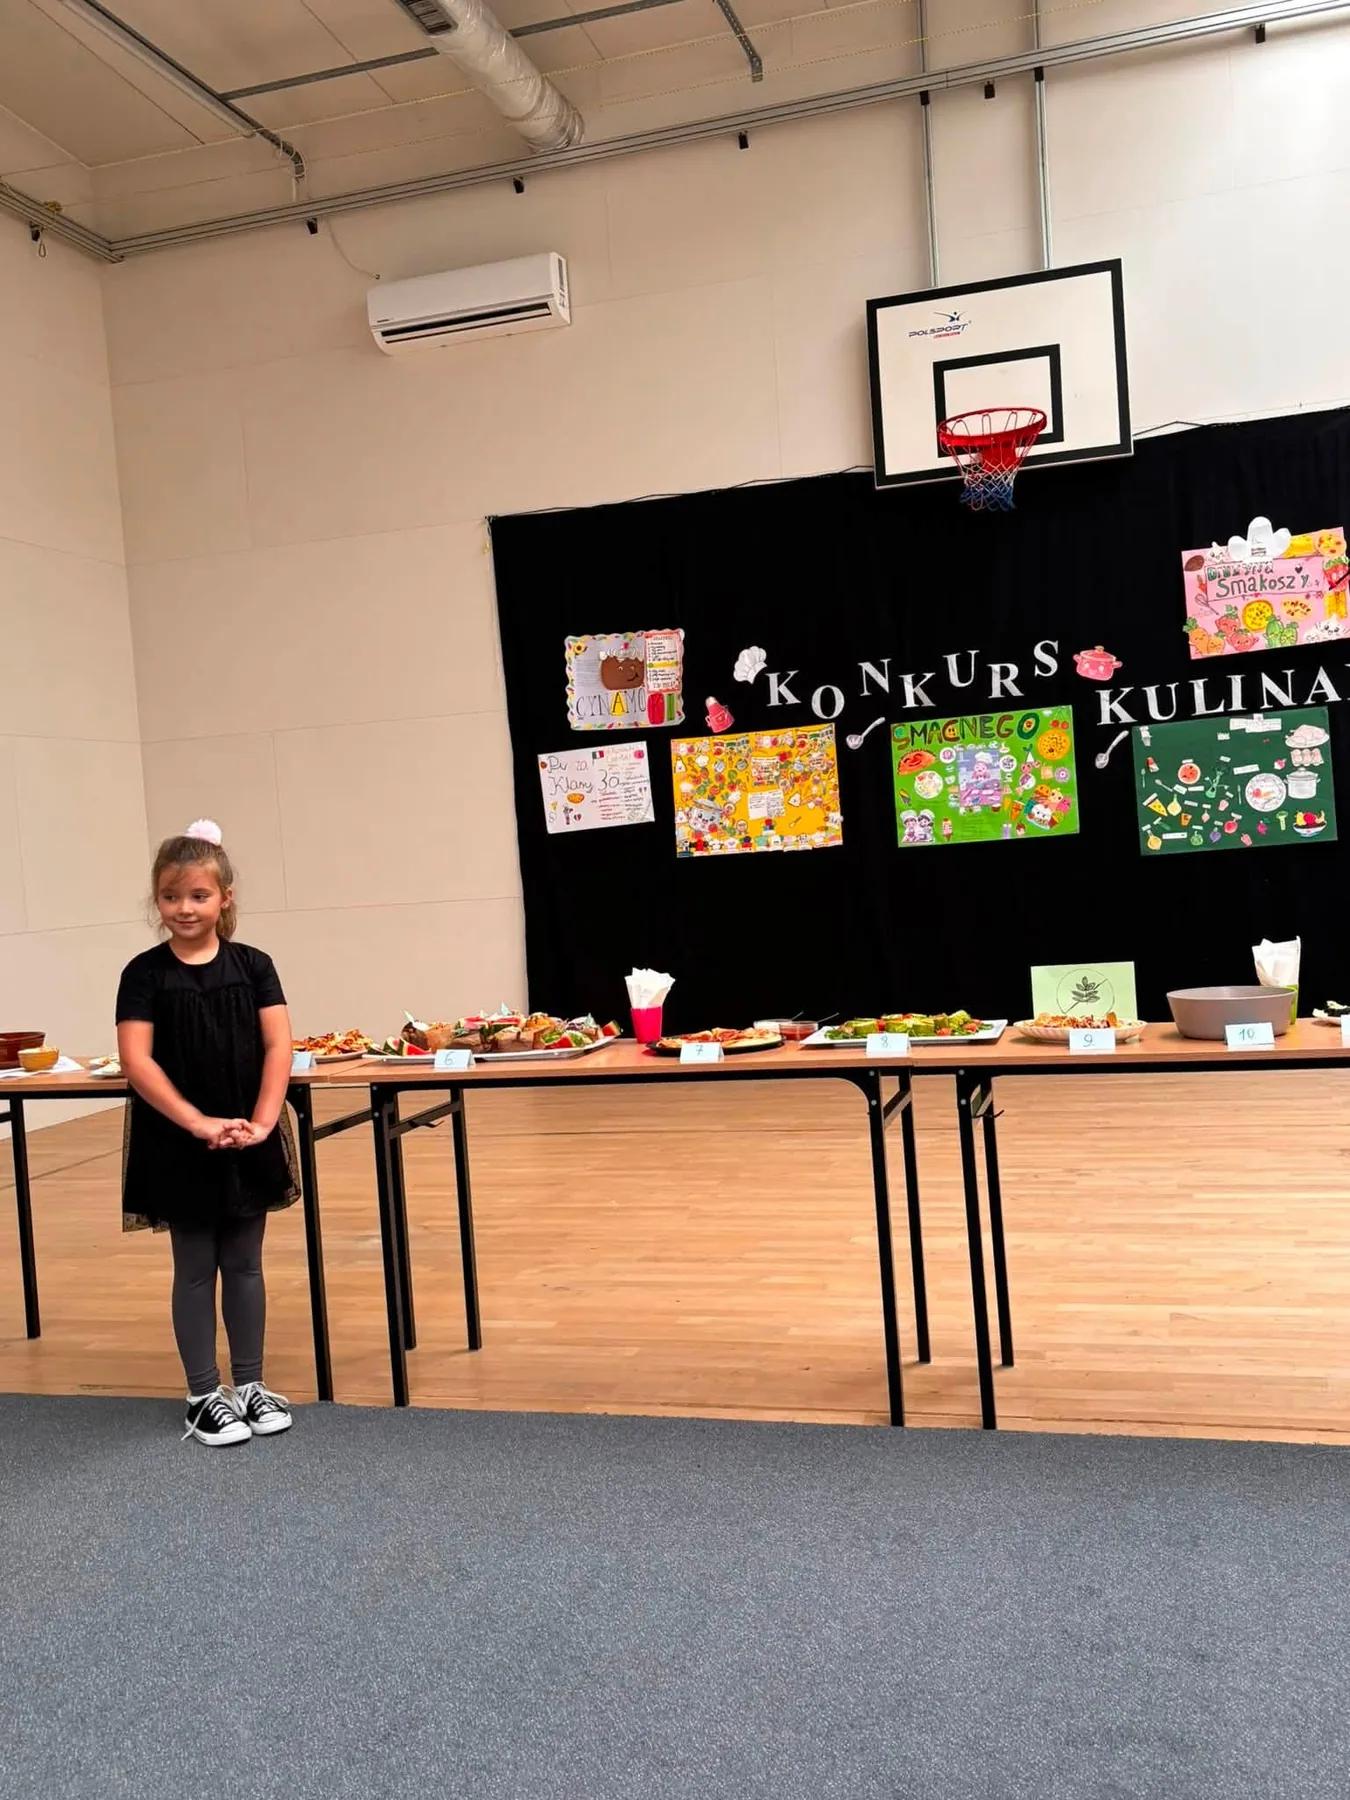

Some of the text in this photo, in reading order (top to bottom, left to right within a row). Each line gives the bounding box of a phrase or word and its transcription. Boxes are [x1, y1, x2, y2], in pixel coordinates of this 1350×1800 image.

[909, 323, 968, 338] POLSPORT
[1216, 574, 1309, 598] Smakoszy
[765, 640, 1059, 719] KONKURS
[1096, 664, 1350, 726] KULINA
[695, 1045, 704, 1056] 7
